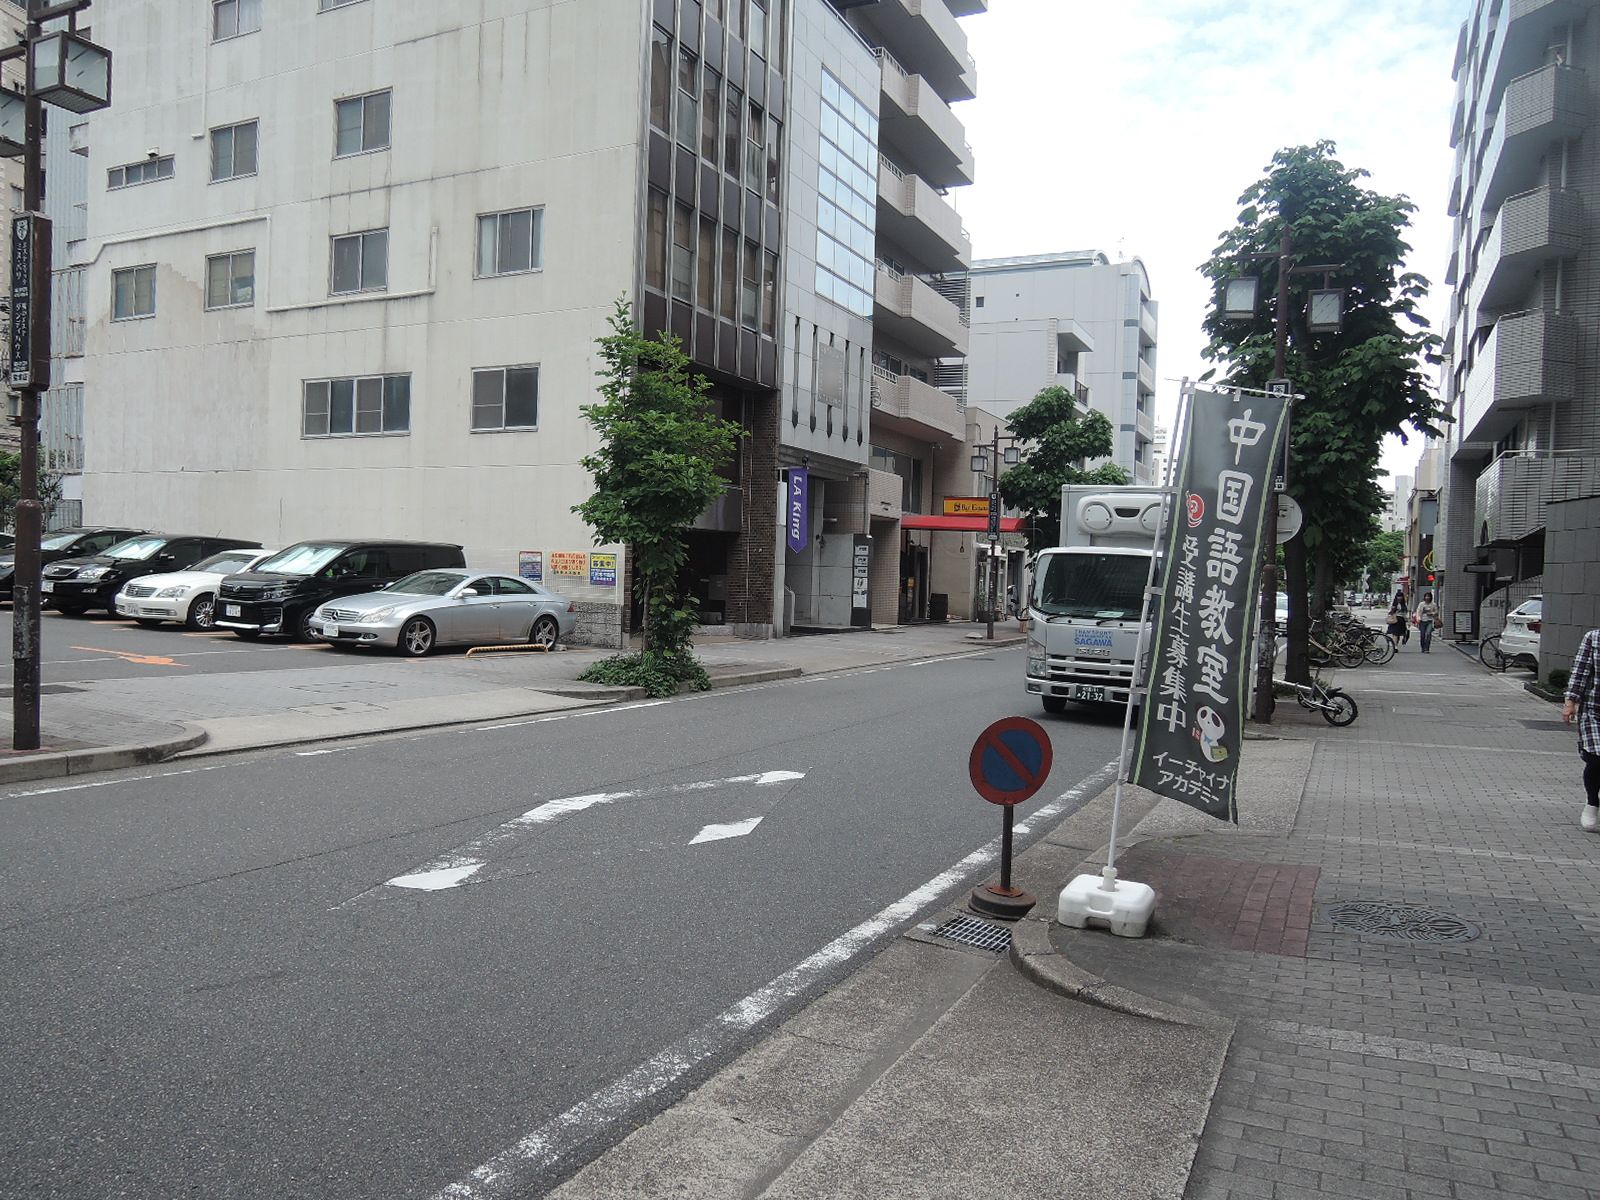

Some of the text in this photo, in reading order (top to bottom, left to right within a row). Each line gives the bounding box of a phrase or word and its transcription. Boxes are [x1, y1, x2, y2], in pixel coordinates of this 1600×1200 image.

[793, 475, 803, 496] LA
[1192, 407, 1266, 706] 中国語教室
[1074, 637, 1113, 647] SAGAWA
[1156, 535, 1200, 734] 受講生募集中
[1076, 647, 1111, 656] ISUZU
[1081, 691, 1103, 701] 21-32
[1152, 751, 1230, 790] イーチャイナ
[1157, 770, 1220, 804] アカデミー
